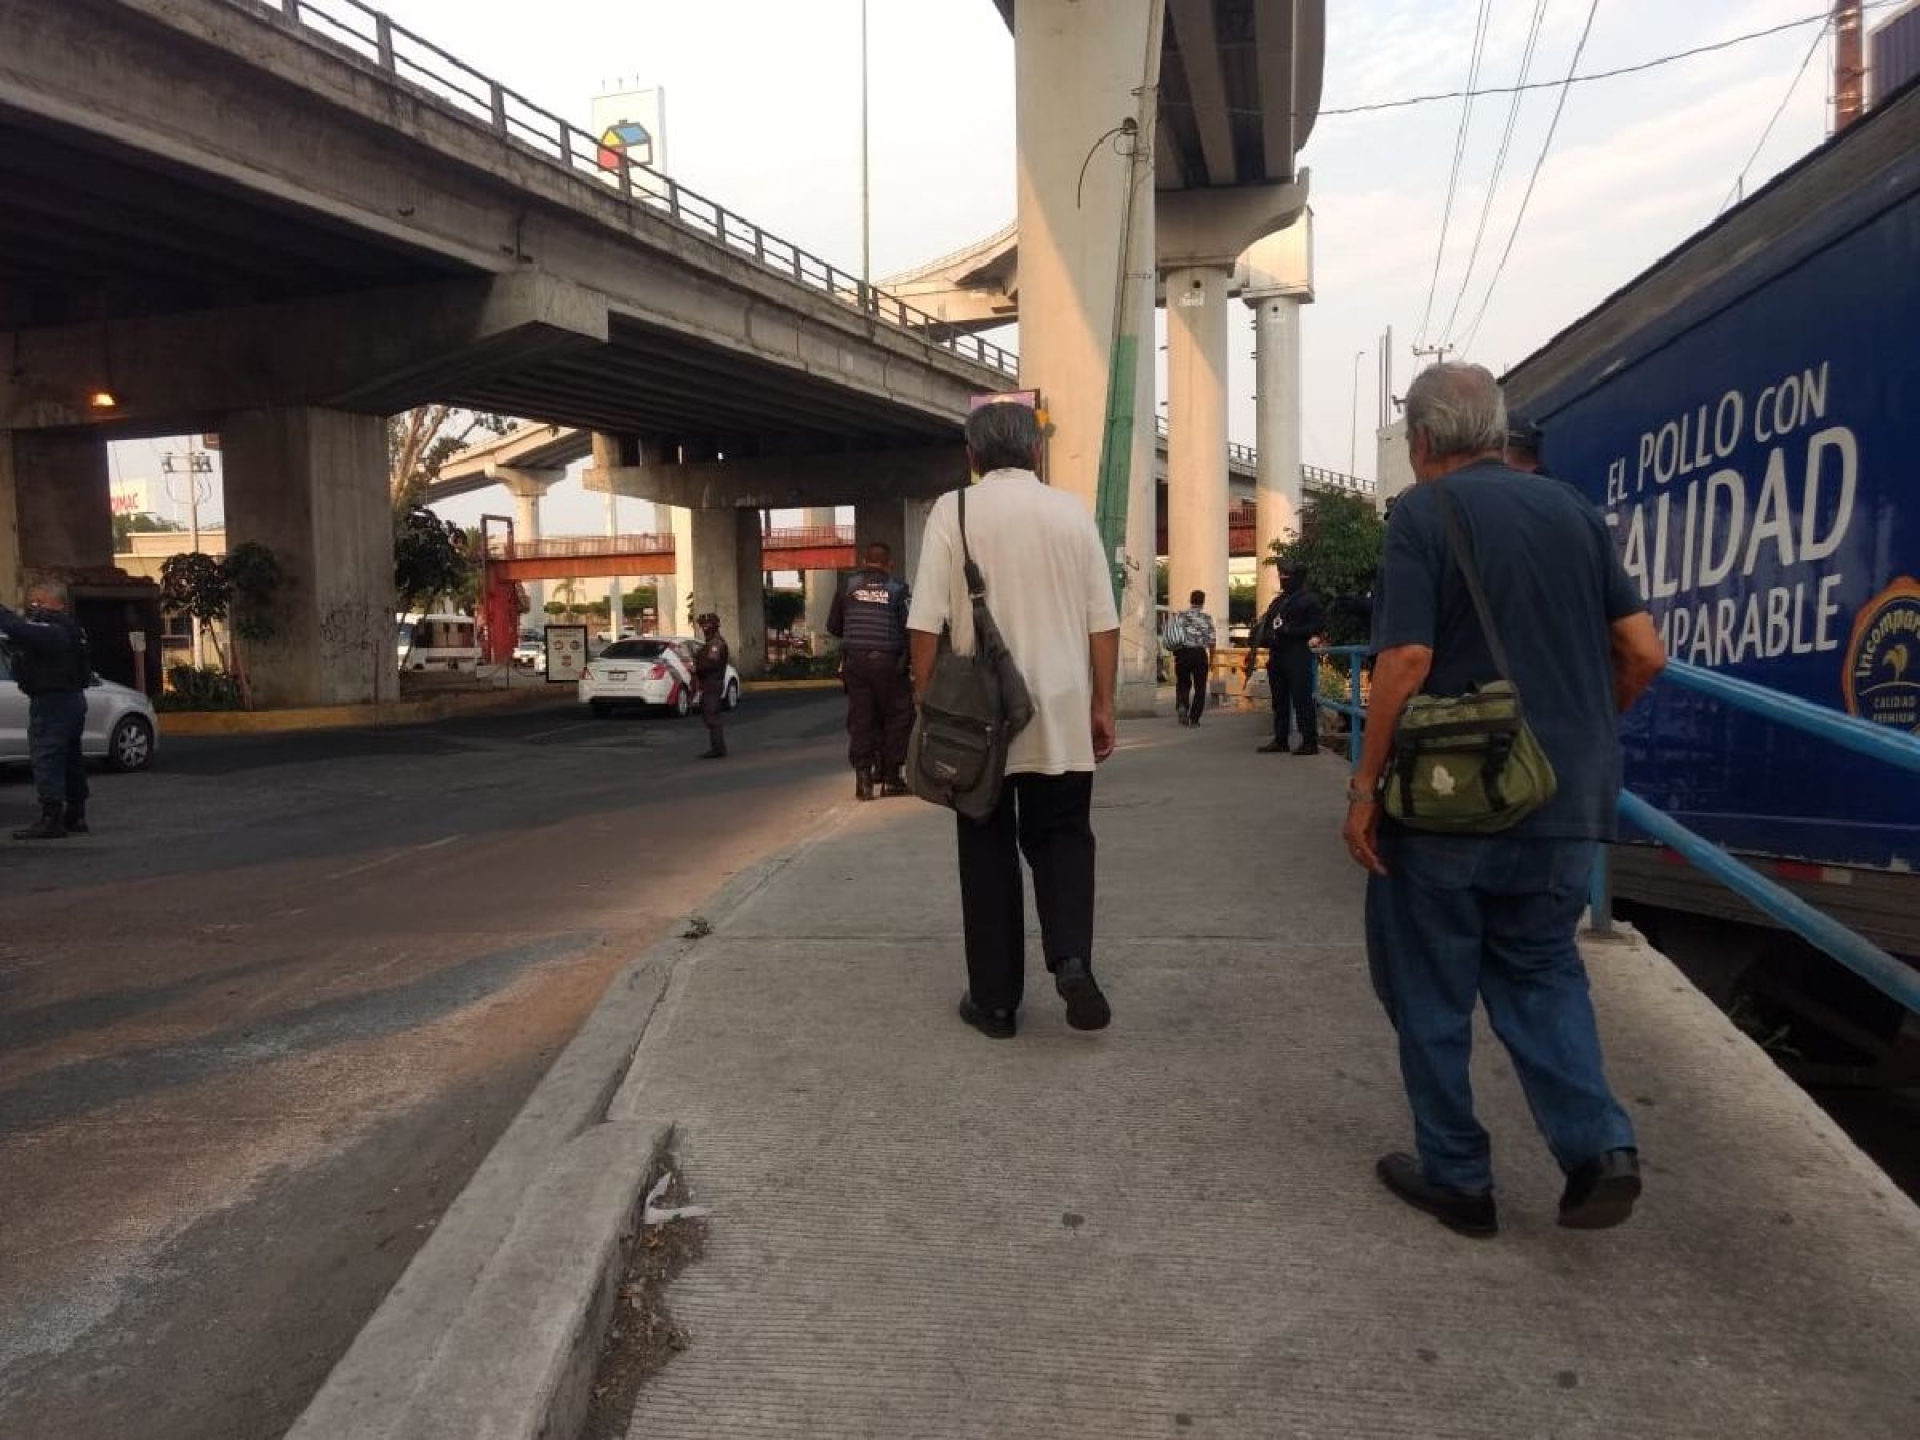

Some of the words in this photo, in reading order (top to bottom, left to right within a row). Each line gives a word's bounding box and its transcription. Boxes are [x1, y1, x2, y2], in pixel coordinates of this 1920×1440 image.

[1607, 457, 1628, 506] EL
[1637, 390, 1744, 492] POLLO
[1754, 360, 1828, 443] CON
[1605, 426, 1857, 601] ALIDAD
[1855, 609, 1920, 677] Incompar
